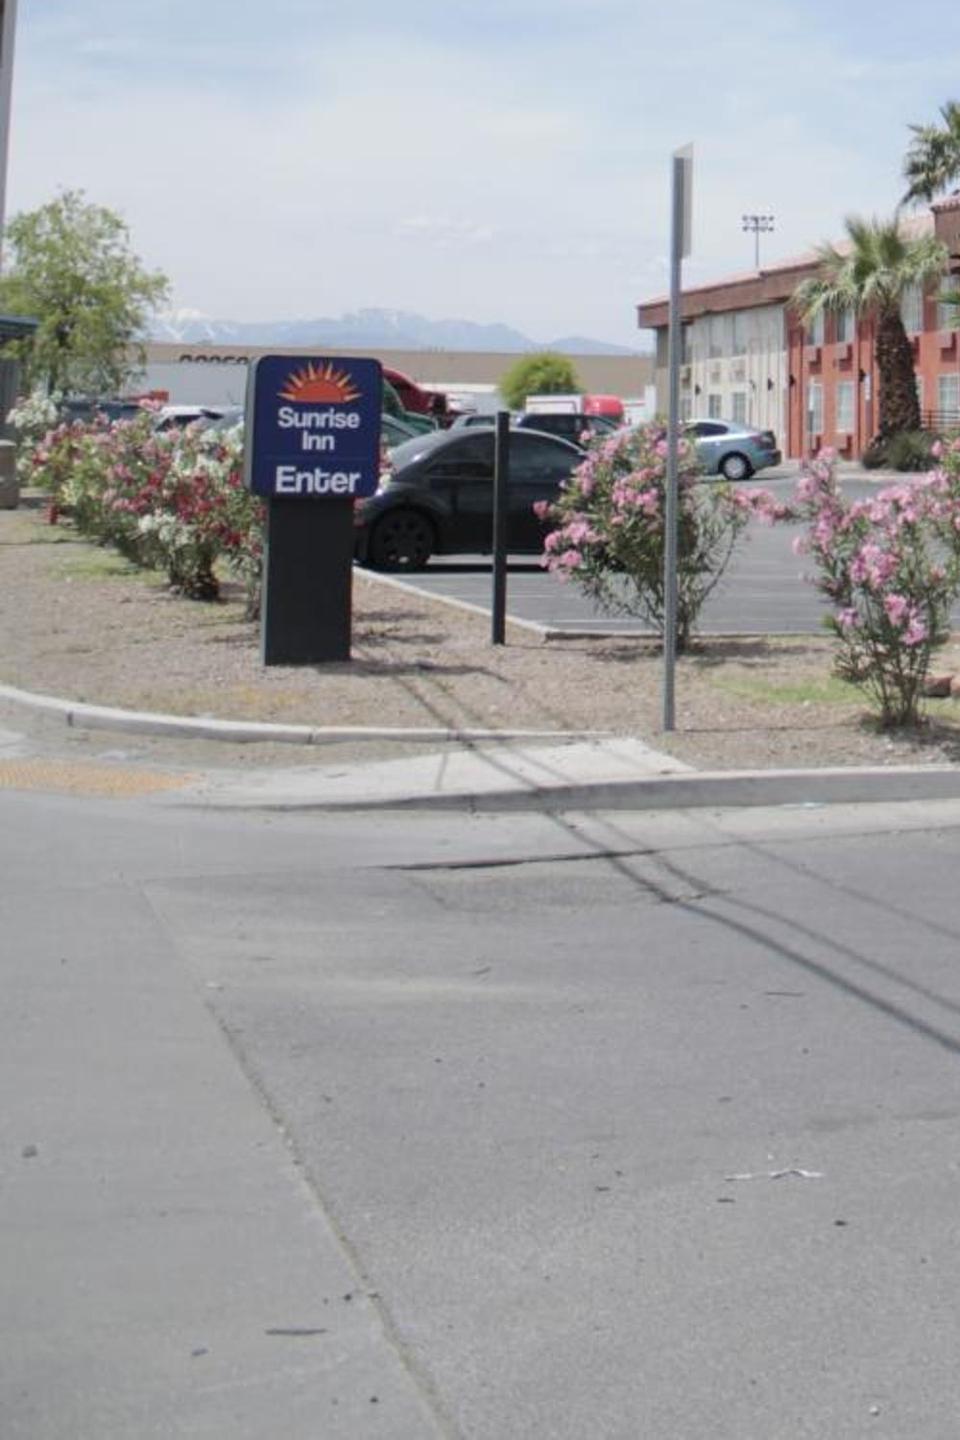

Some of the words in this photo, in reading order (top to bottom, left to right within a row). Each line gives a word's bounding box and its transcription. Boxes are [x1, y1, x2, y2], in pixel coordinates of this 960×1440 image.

[277, 406, 360, 429] Sunrise
[302, 430, 335, 451] Inn
[275, 465, 361, 493] Enter
